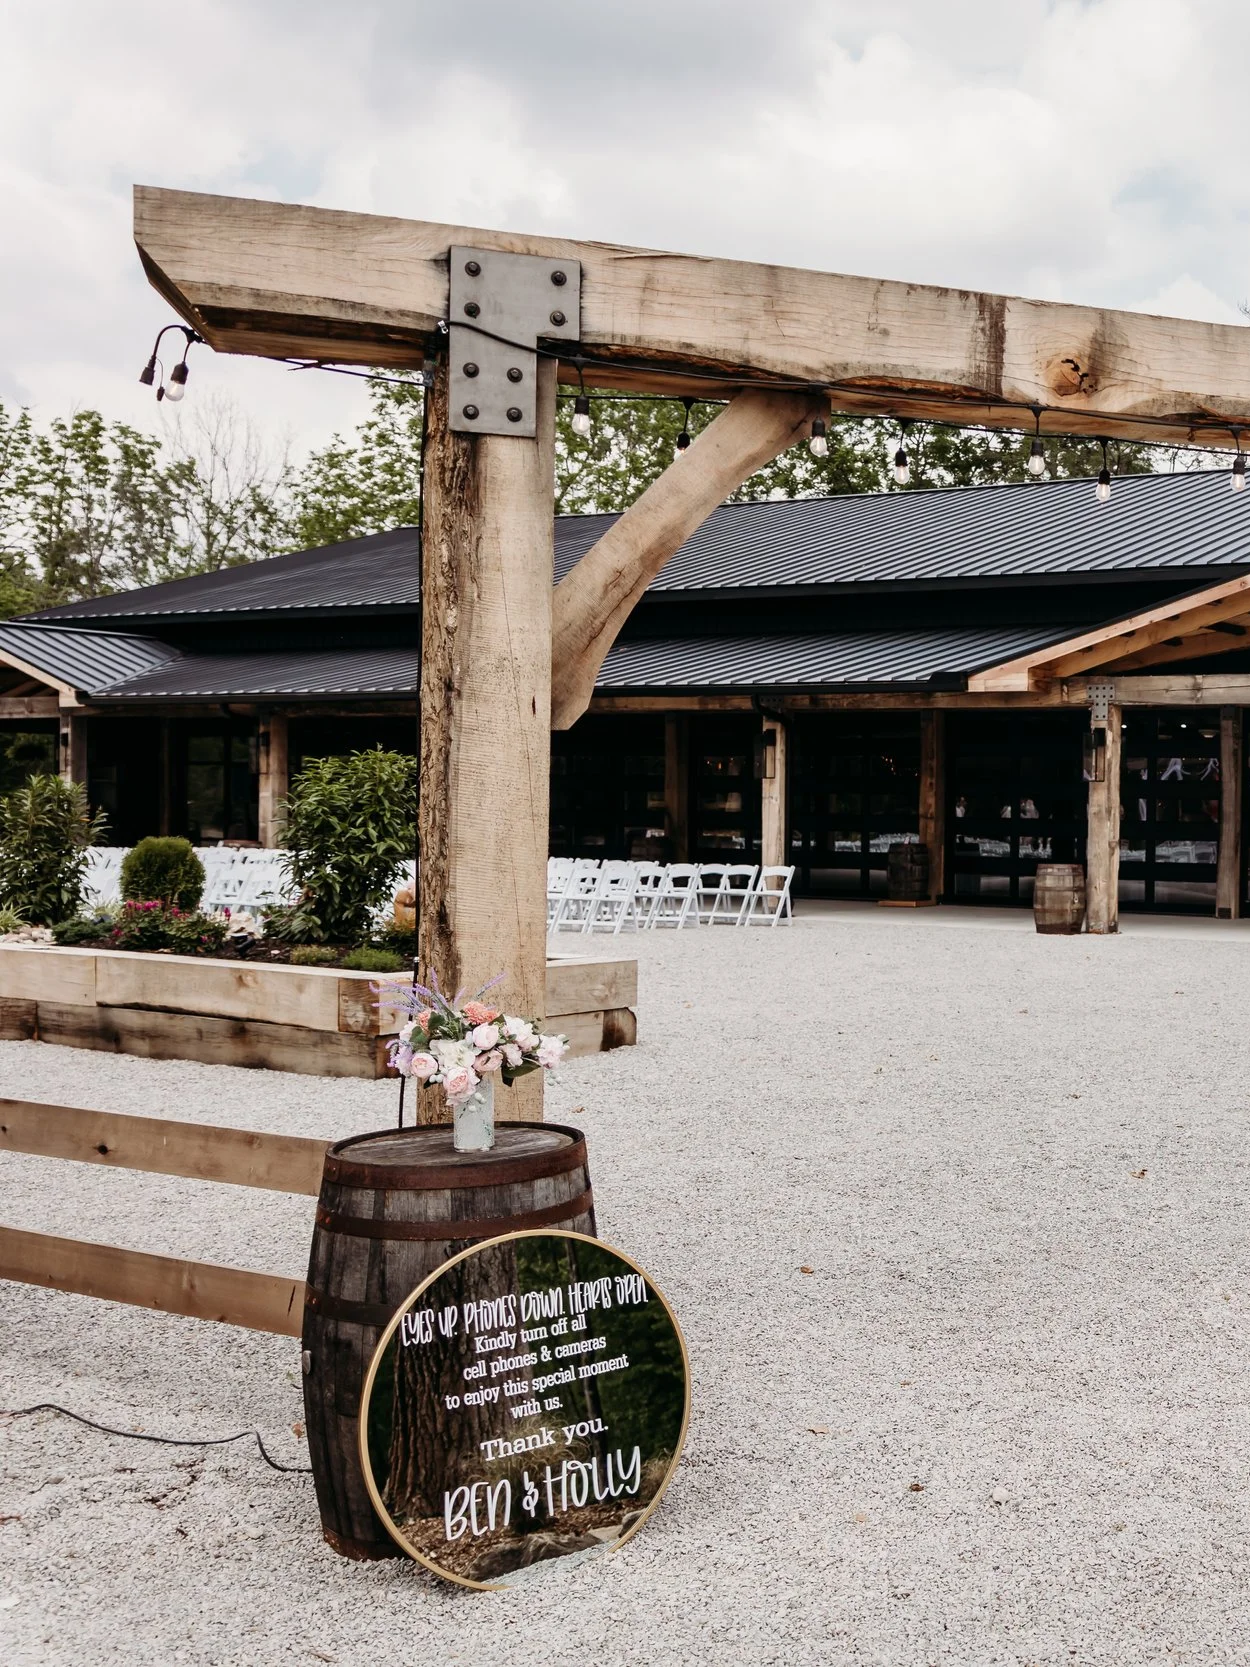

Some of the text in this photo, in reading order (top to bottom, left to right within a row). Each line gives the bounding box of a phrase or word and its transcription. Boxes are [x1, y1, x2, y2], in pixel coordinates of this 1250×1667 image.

[401, 1308, 435, 1347] EYES
[438, 1305, 458, 1338] UP.
[463, 1294, 517, 1334] PHONES
[567, 1277, 612, 1315] HEARTS
[473, 1313, 588, 1354] Kindly turn off all
[462, 1336, 607, 1381] cell phones & cameras
[444, 1353, 630, 1410] to enjoy this special moment
[510, 1396, 564, 1419] with us.
[480, 1417, 609, 1462] Thank you.
[443, 1445, 642, 1541] BEN & HOLLY
